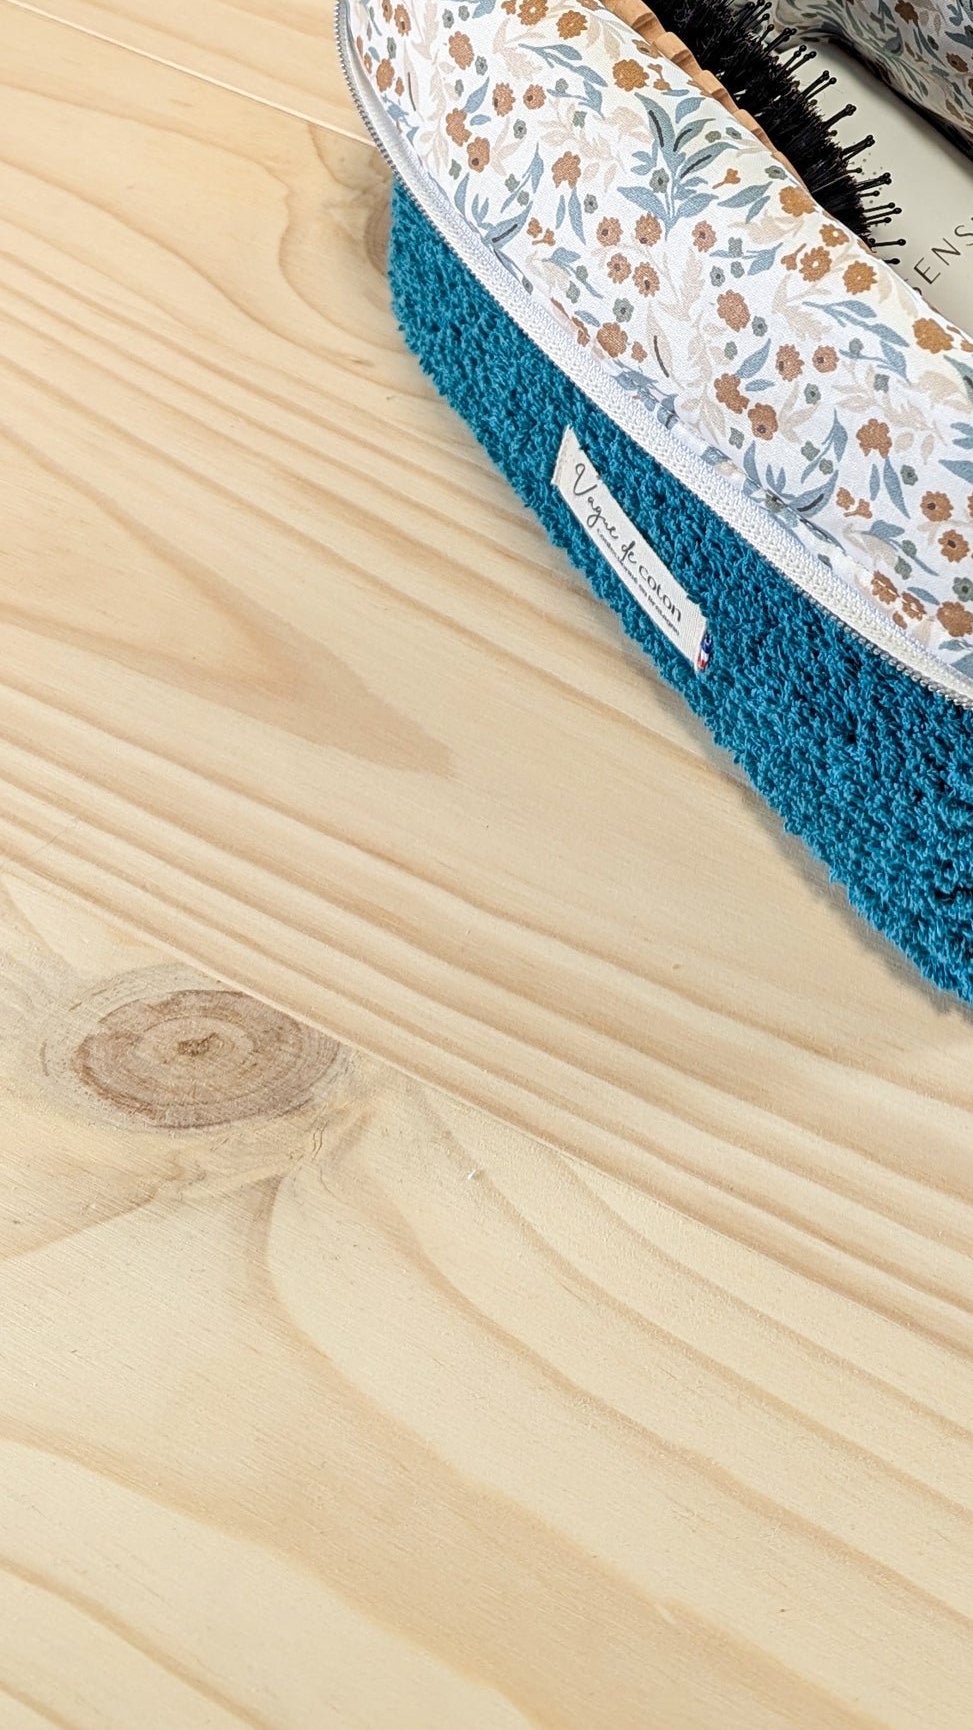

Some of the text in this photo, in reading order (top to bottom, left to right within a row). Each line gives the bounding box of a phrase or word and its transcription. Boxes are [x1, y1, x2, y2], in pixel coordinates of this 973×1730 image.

[573, 463, 682, 622] Vague de coton
